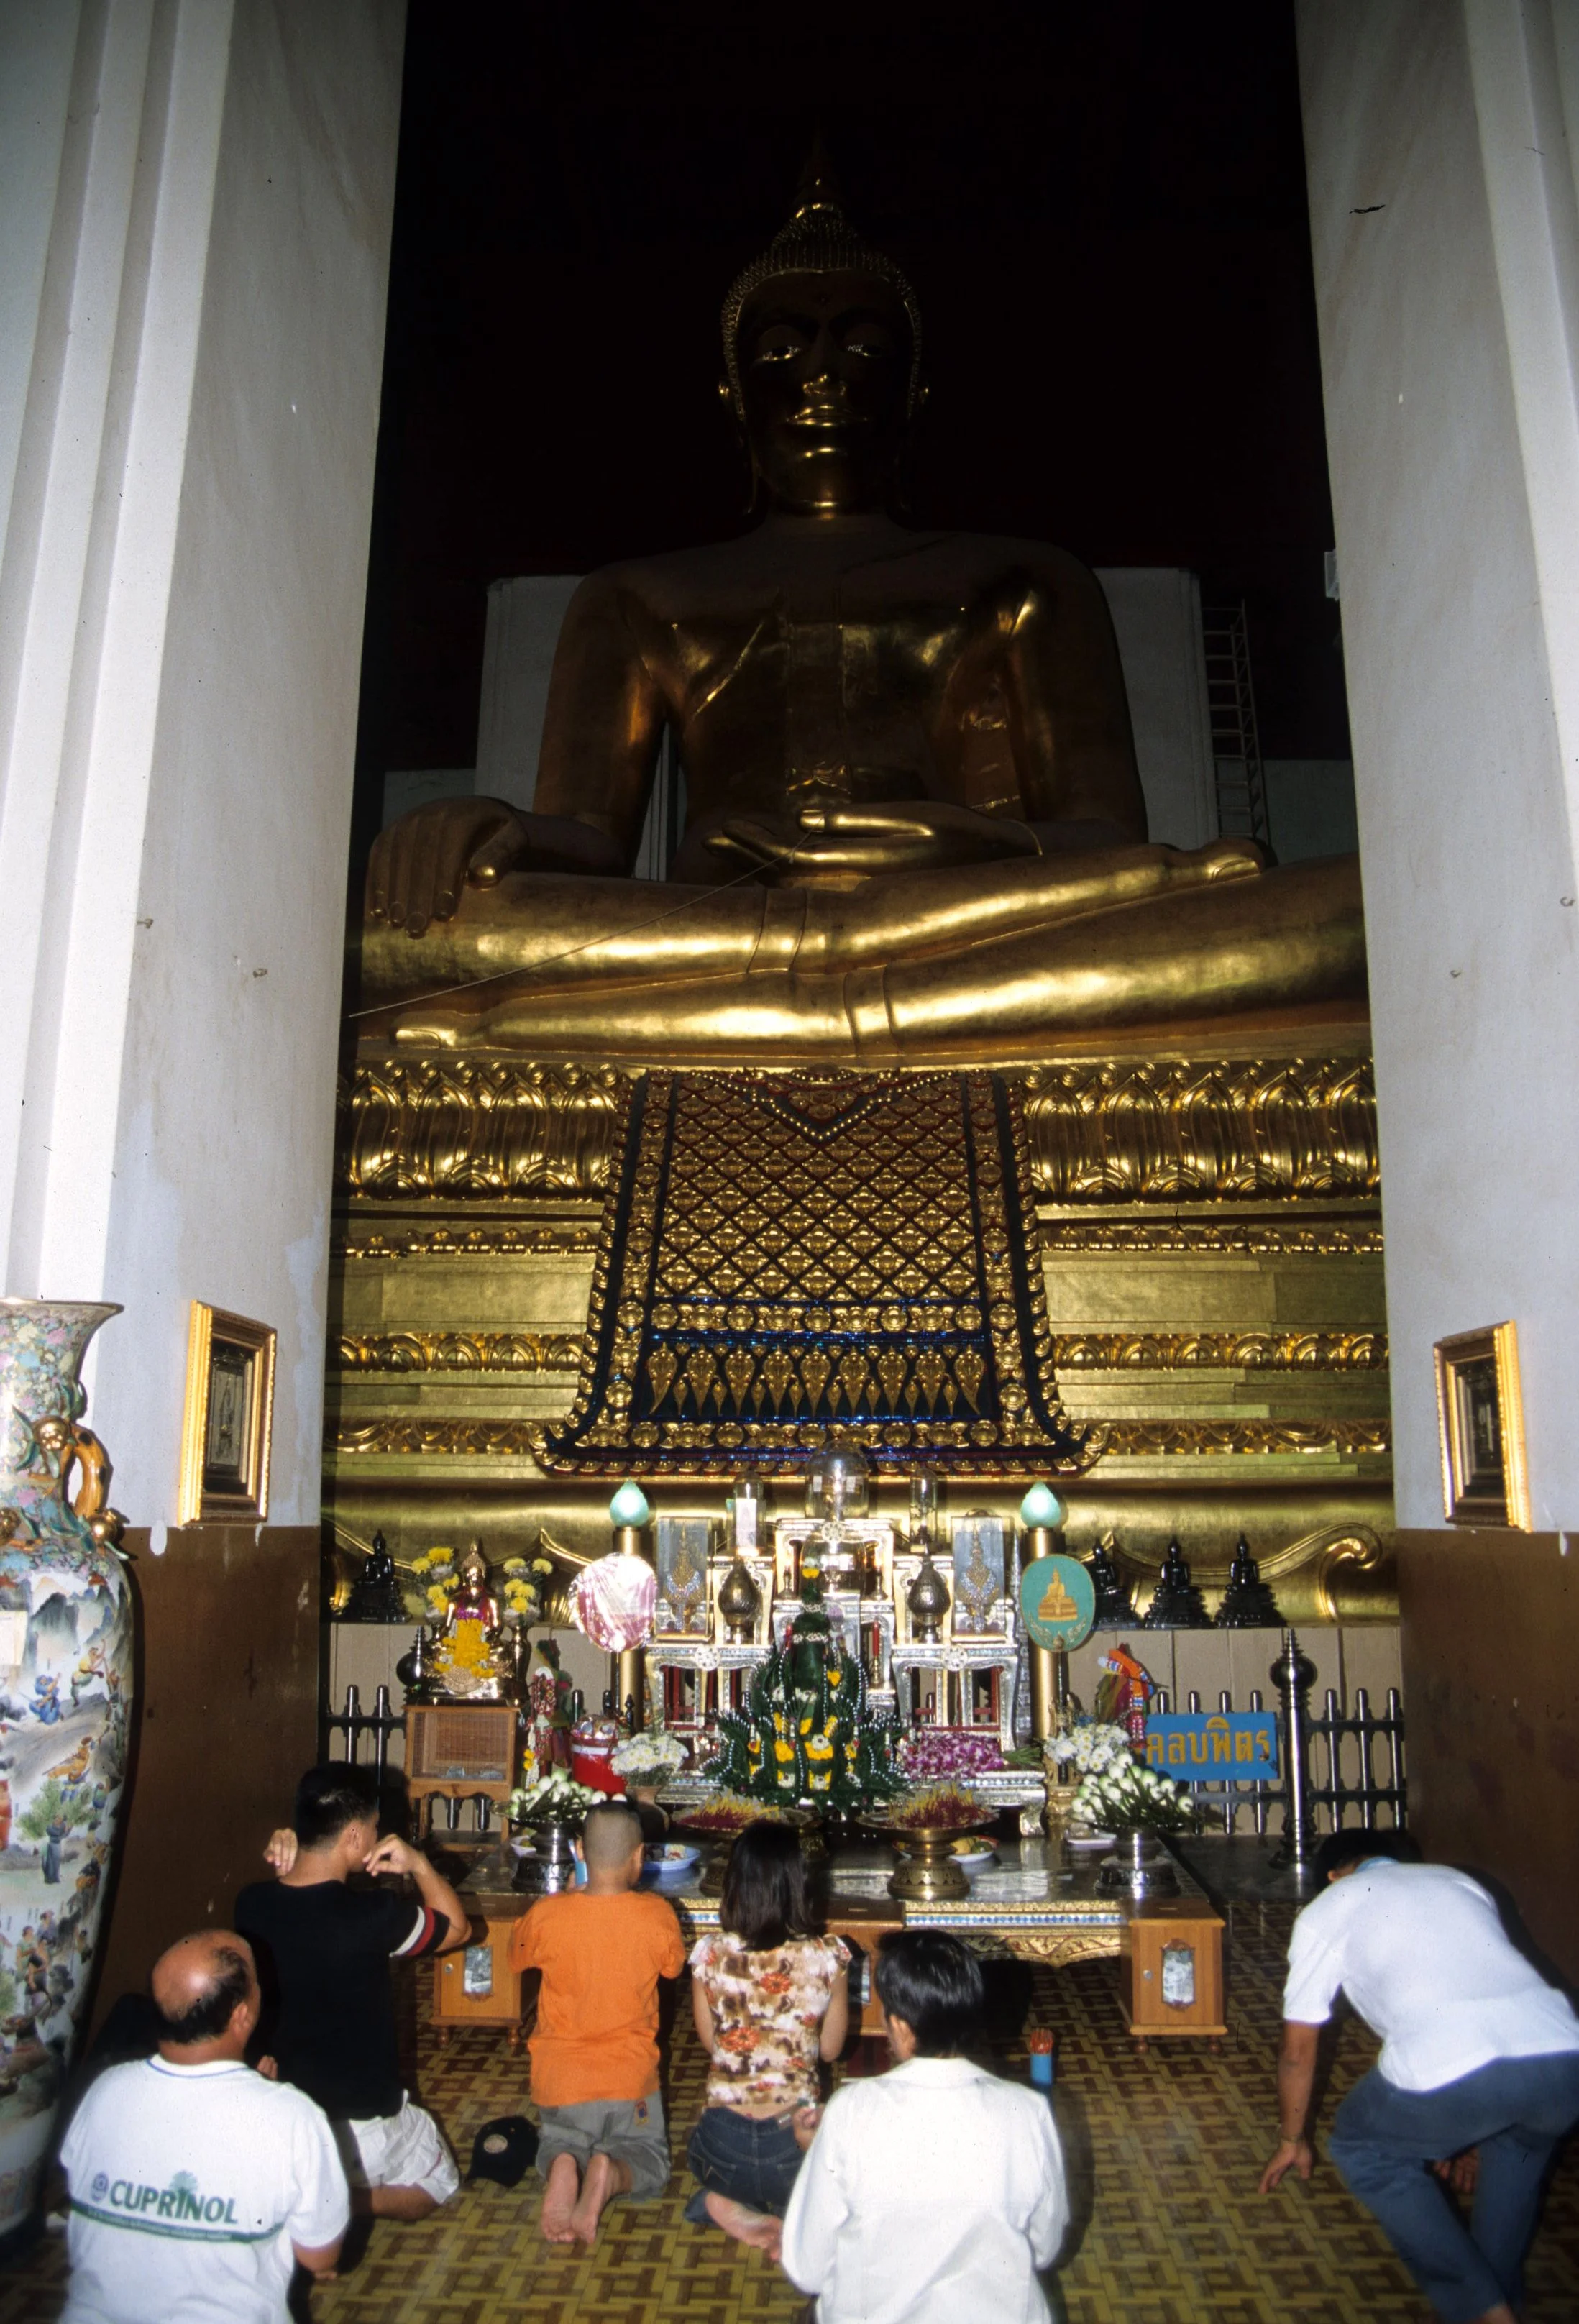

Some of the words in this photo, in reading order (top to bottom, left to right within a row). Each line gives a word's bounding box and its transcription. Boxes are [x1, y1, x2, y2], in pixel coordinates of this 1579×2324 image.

[1135, 1716, 1271, 1765] คลบพิตร
[111, 2179, 238, 2224] CUPRINOL
